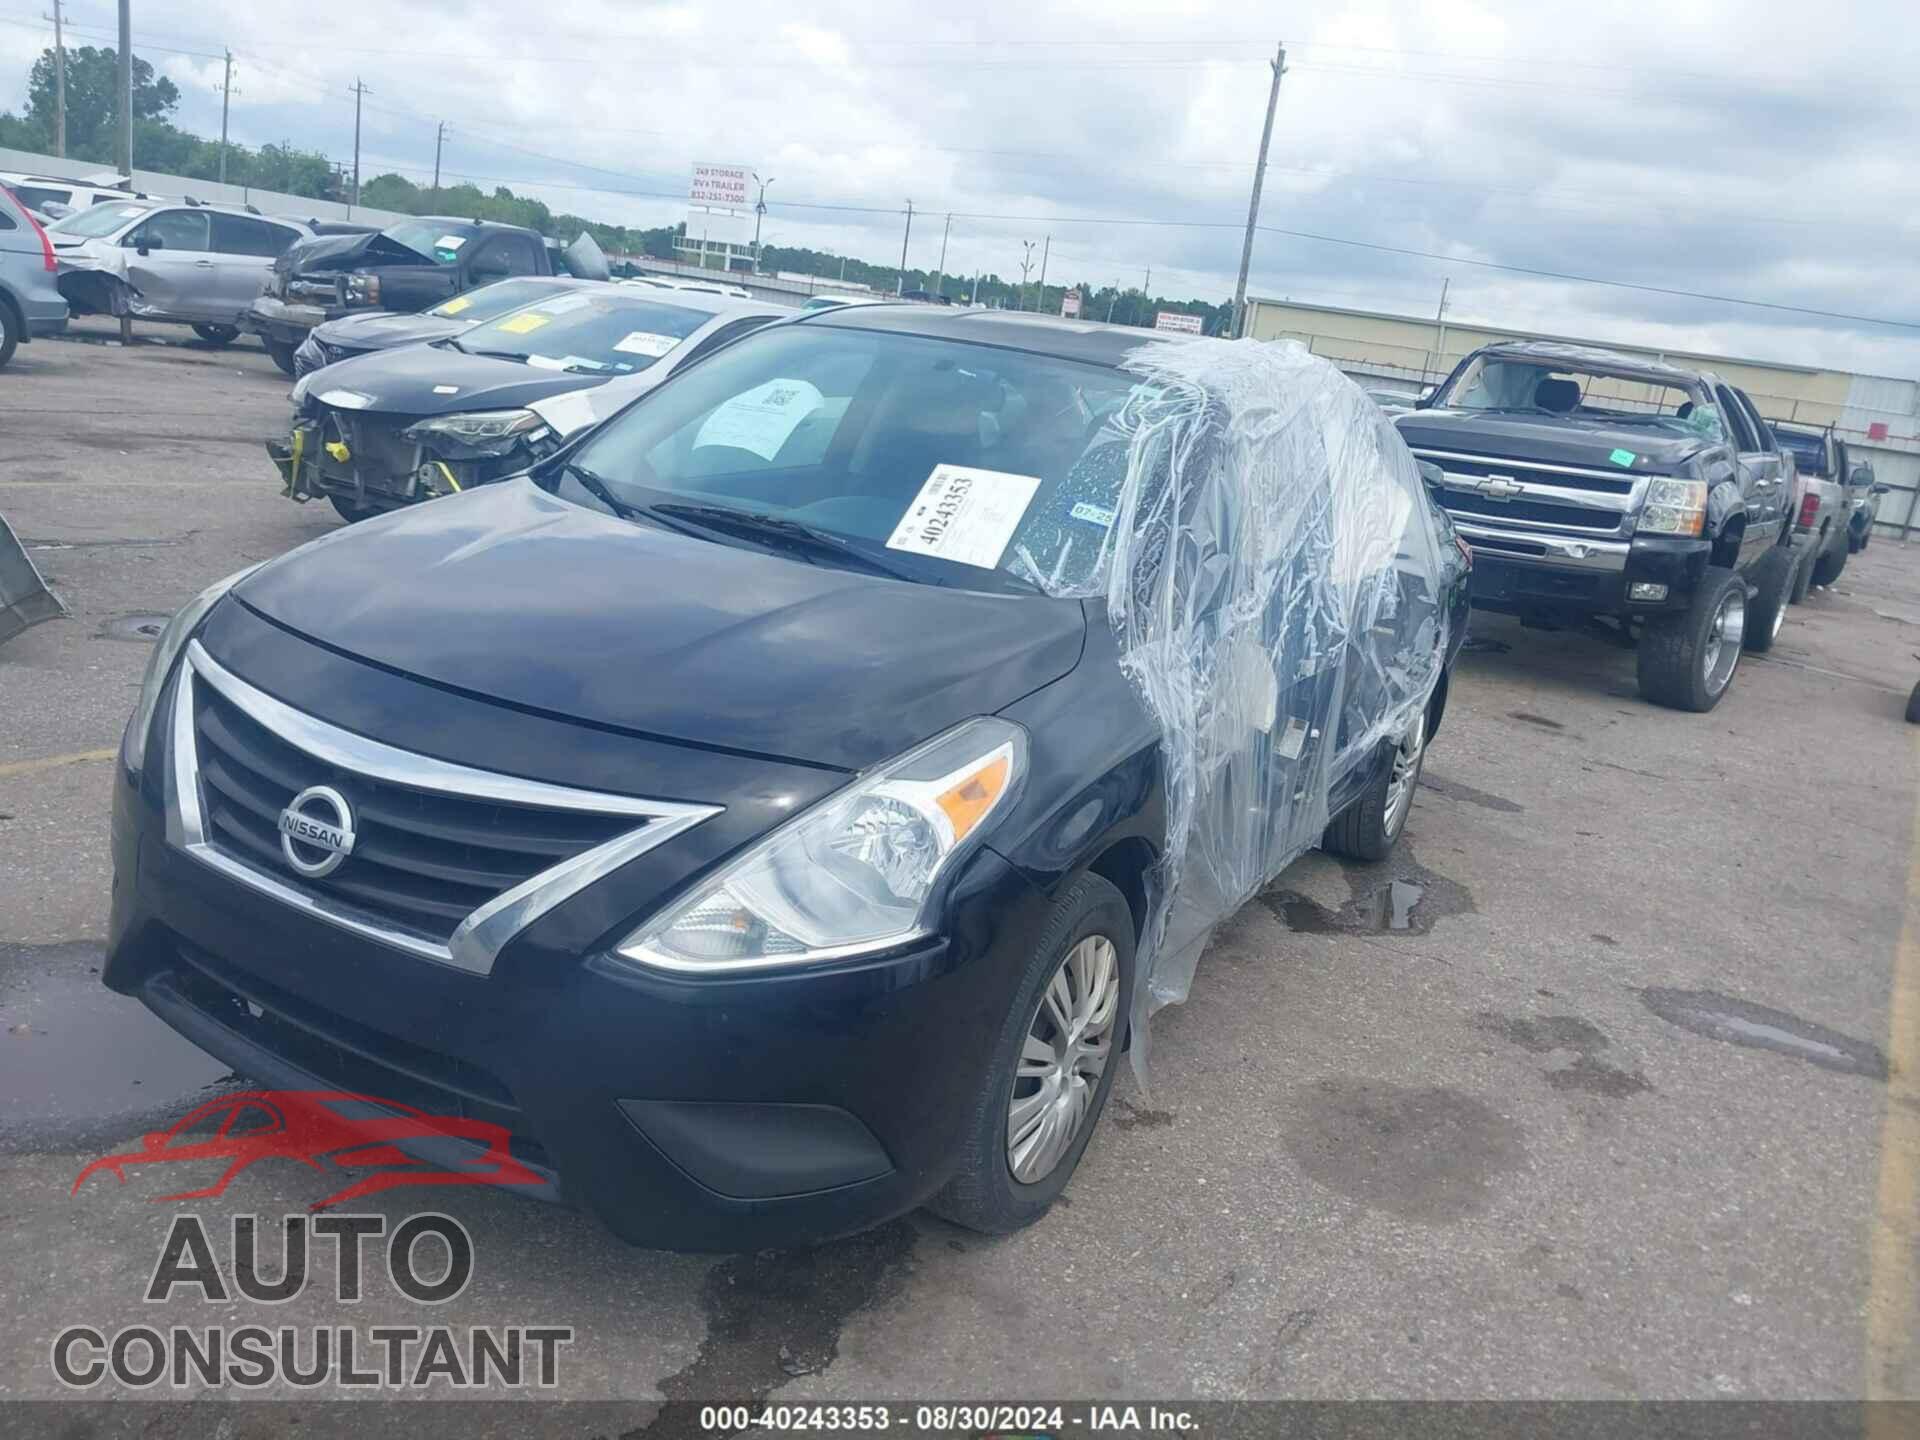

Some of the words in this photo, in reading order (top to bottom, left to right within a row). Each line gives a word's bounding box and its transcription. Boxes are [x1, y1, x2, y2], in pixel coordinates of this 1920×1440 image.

[711, 168, 744, 179] STORAGE
[711, 181, 745, 191] TRAILER
[919, 477, 974, 546] 40243353
[283, 815, 343, 848] NISSAN
